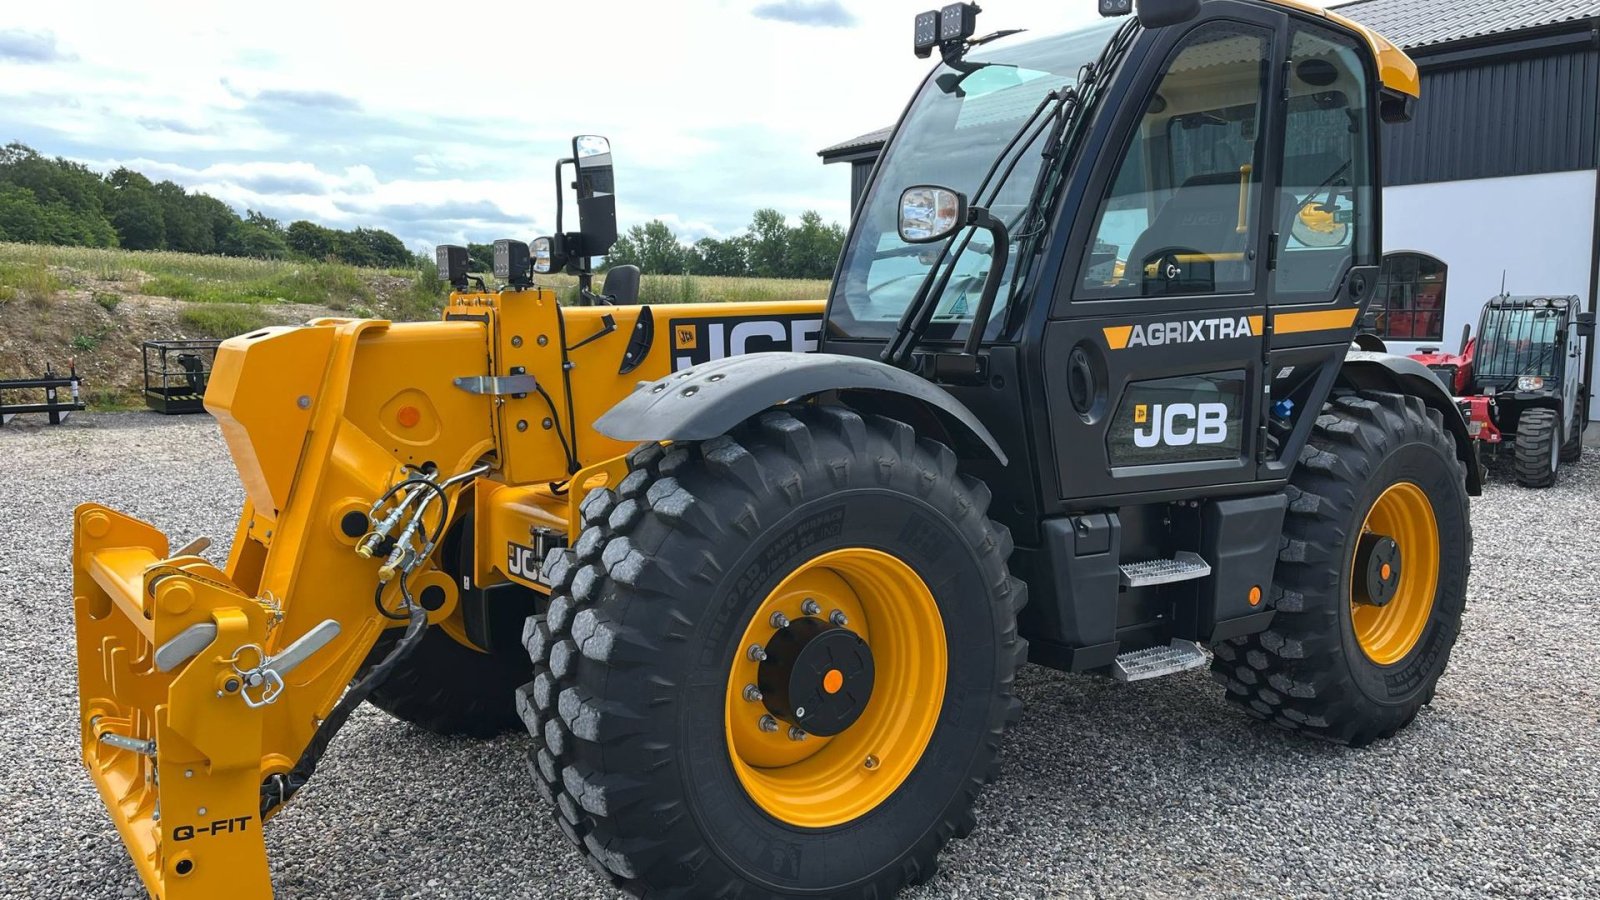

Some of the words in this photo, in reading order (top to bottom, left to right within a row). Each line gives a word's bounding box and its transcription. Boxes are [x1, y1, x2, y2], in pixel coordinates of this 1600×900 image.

[1127, 316, 1252, 348] AGRIXTRA
[1133, 402, 1228, 448] JCB
[508, 546, 552, 587] JC
[173, 816, 253, 842] Q-FIT
